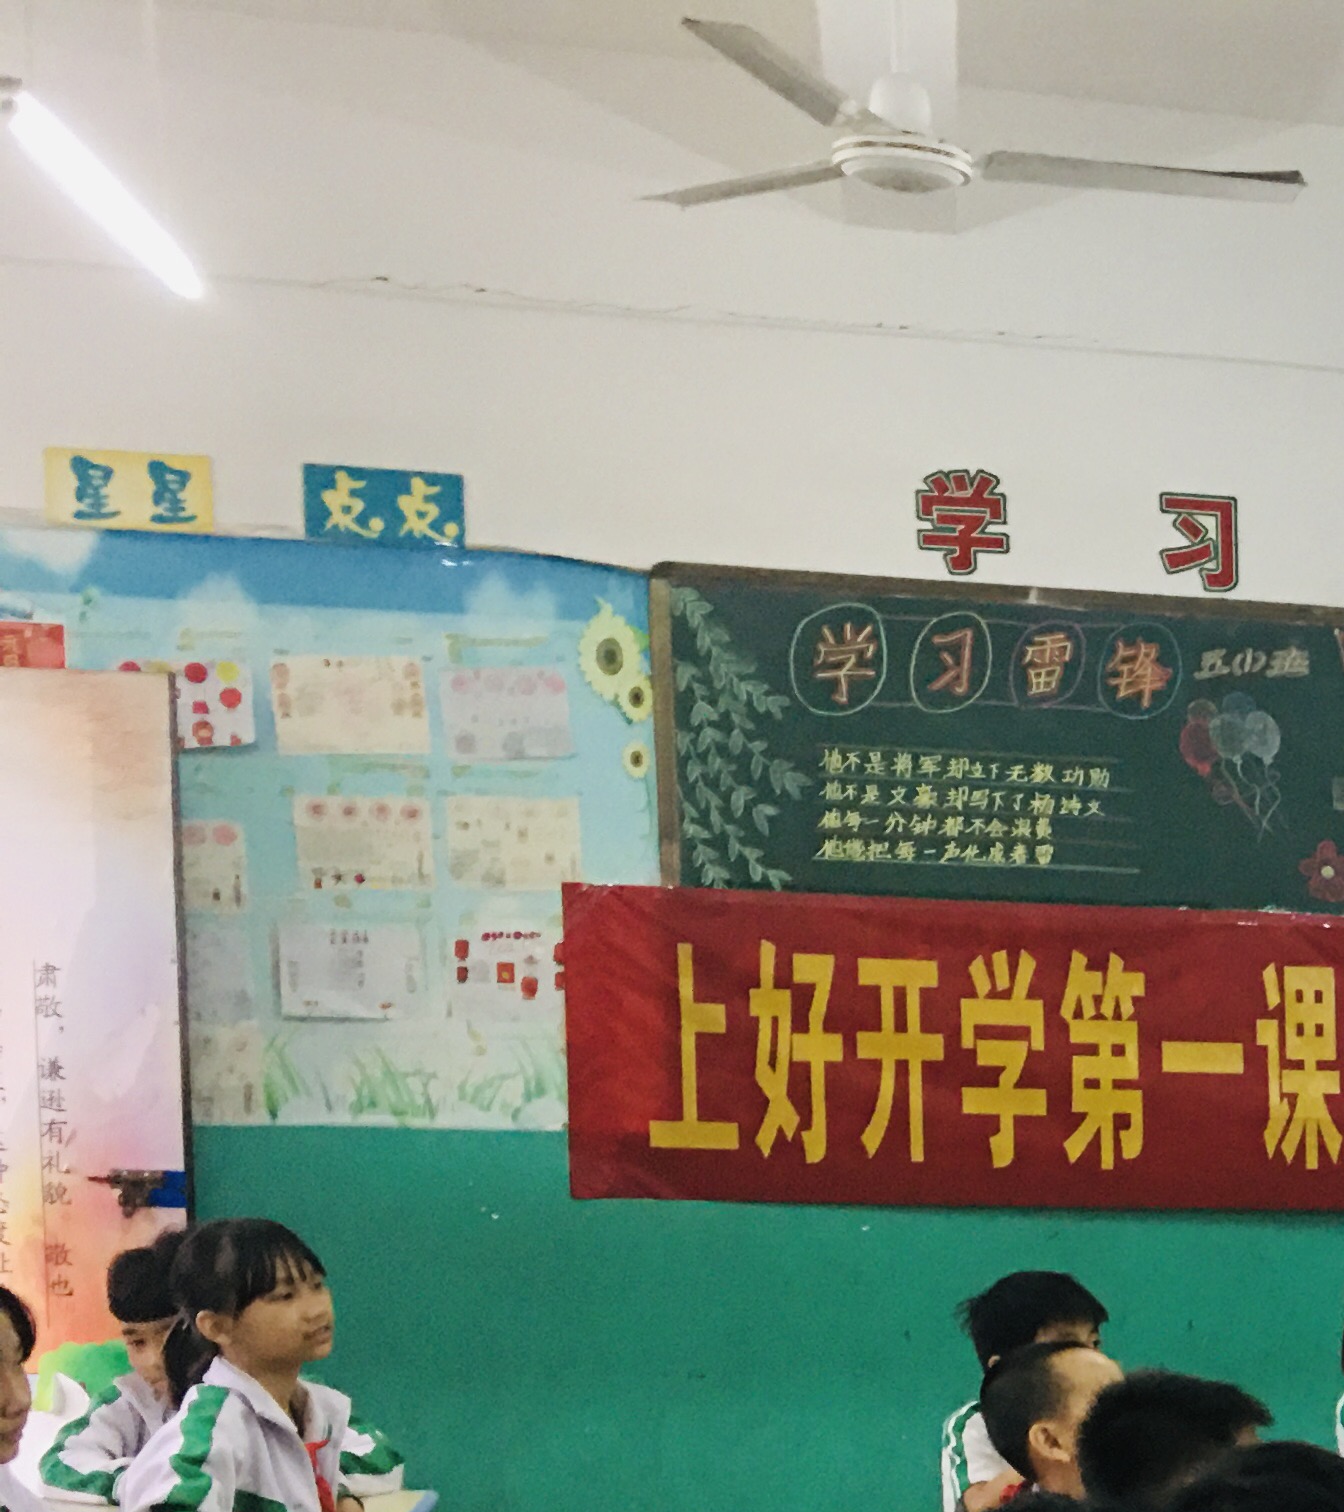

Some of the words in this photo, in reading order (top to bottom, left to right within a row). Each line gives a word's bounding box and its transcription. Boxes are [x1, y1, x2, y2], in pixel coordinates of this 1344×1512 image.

[69, 455, 197, 524] 星星
[321, 470, 460, 541] 点点
[813, 622, 1171, 708] 学习雷锋
[648, 939, 1344, 1171] 上好开学第一课
